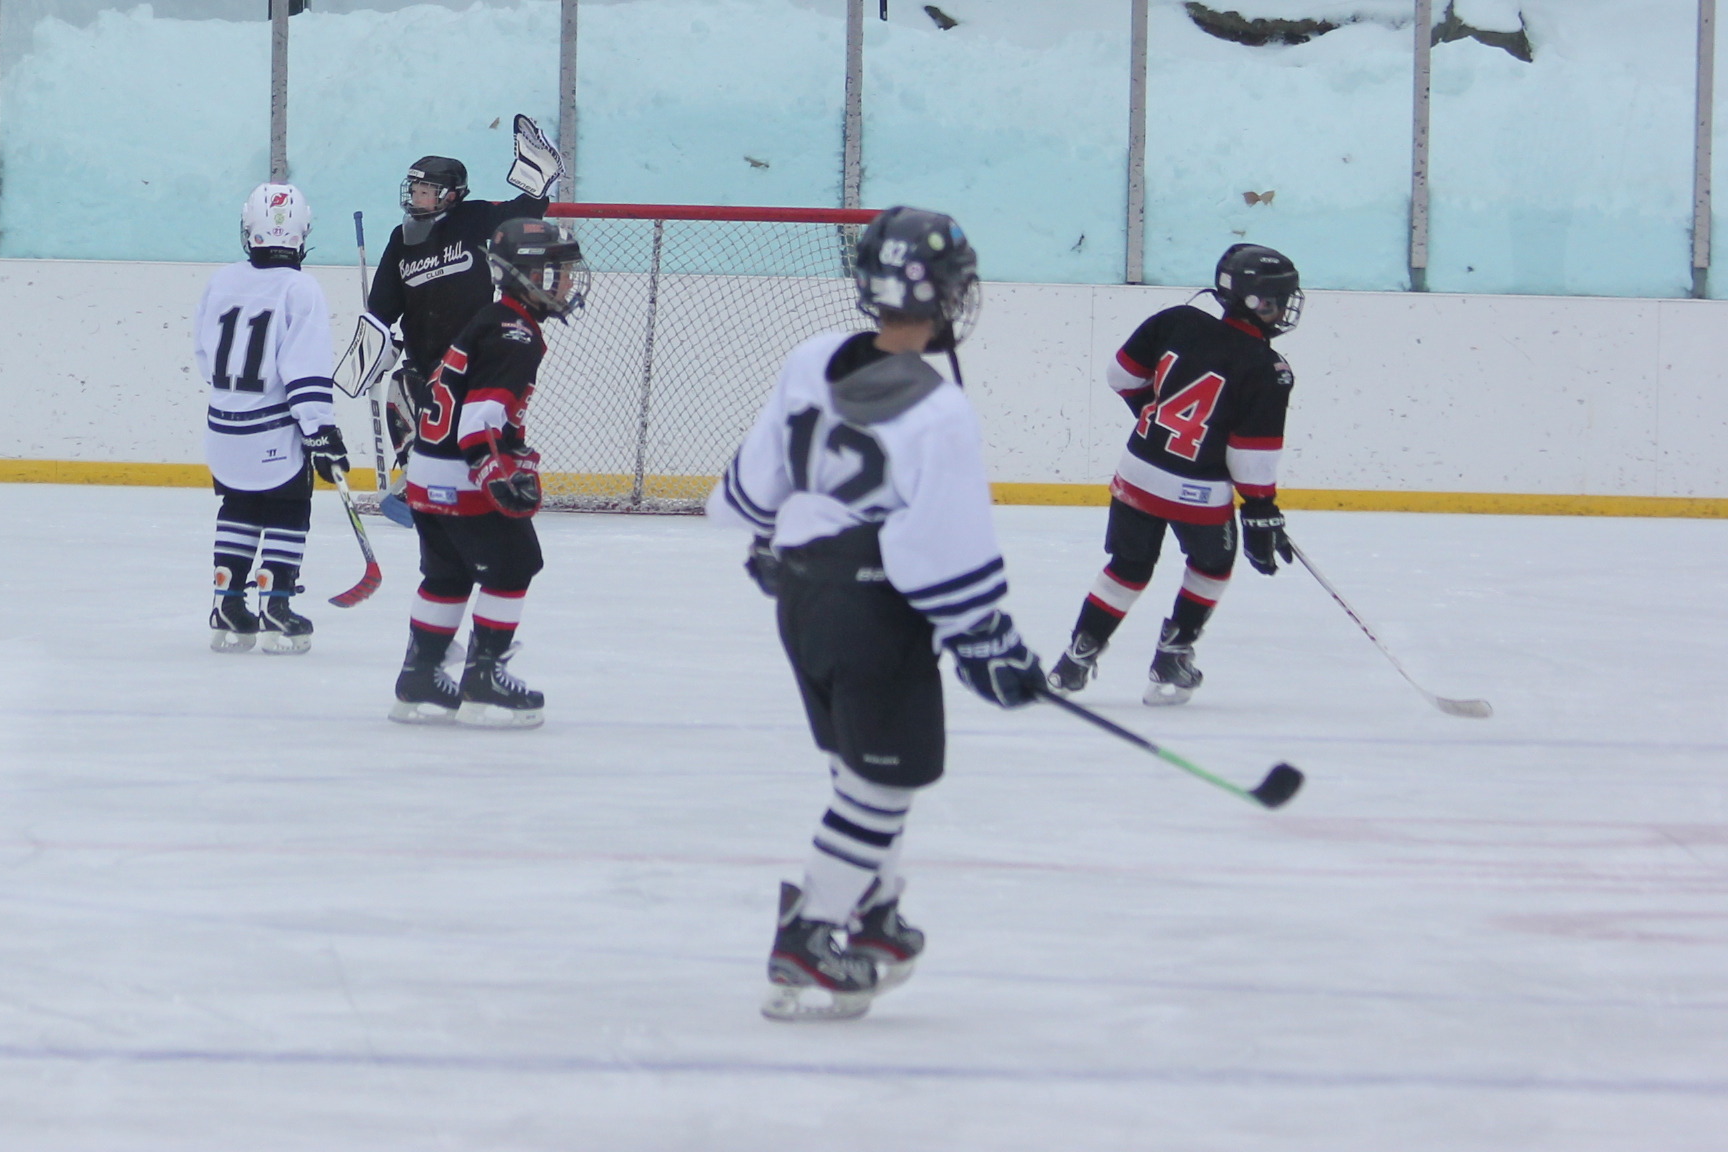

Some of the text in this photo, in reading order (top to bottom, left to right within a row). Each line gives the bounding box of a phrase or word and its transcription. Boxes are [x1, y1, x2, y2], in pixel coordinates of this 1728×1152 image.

[398, 240, 463, 280] Beacon Hill
[425, 268, 445, 280] CLUB
[211, 305, 275, 394] 11
